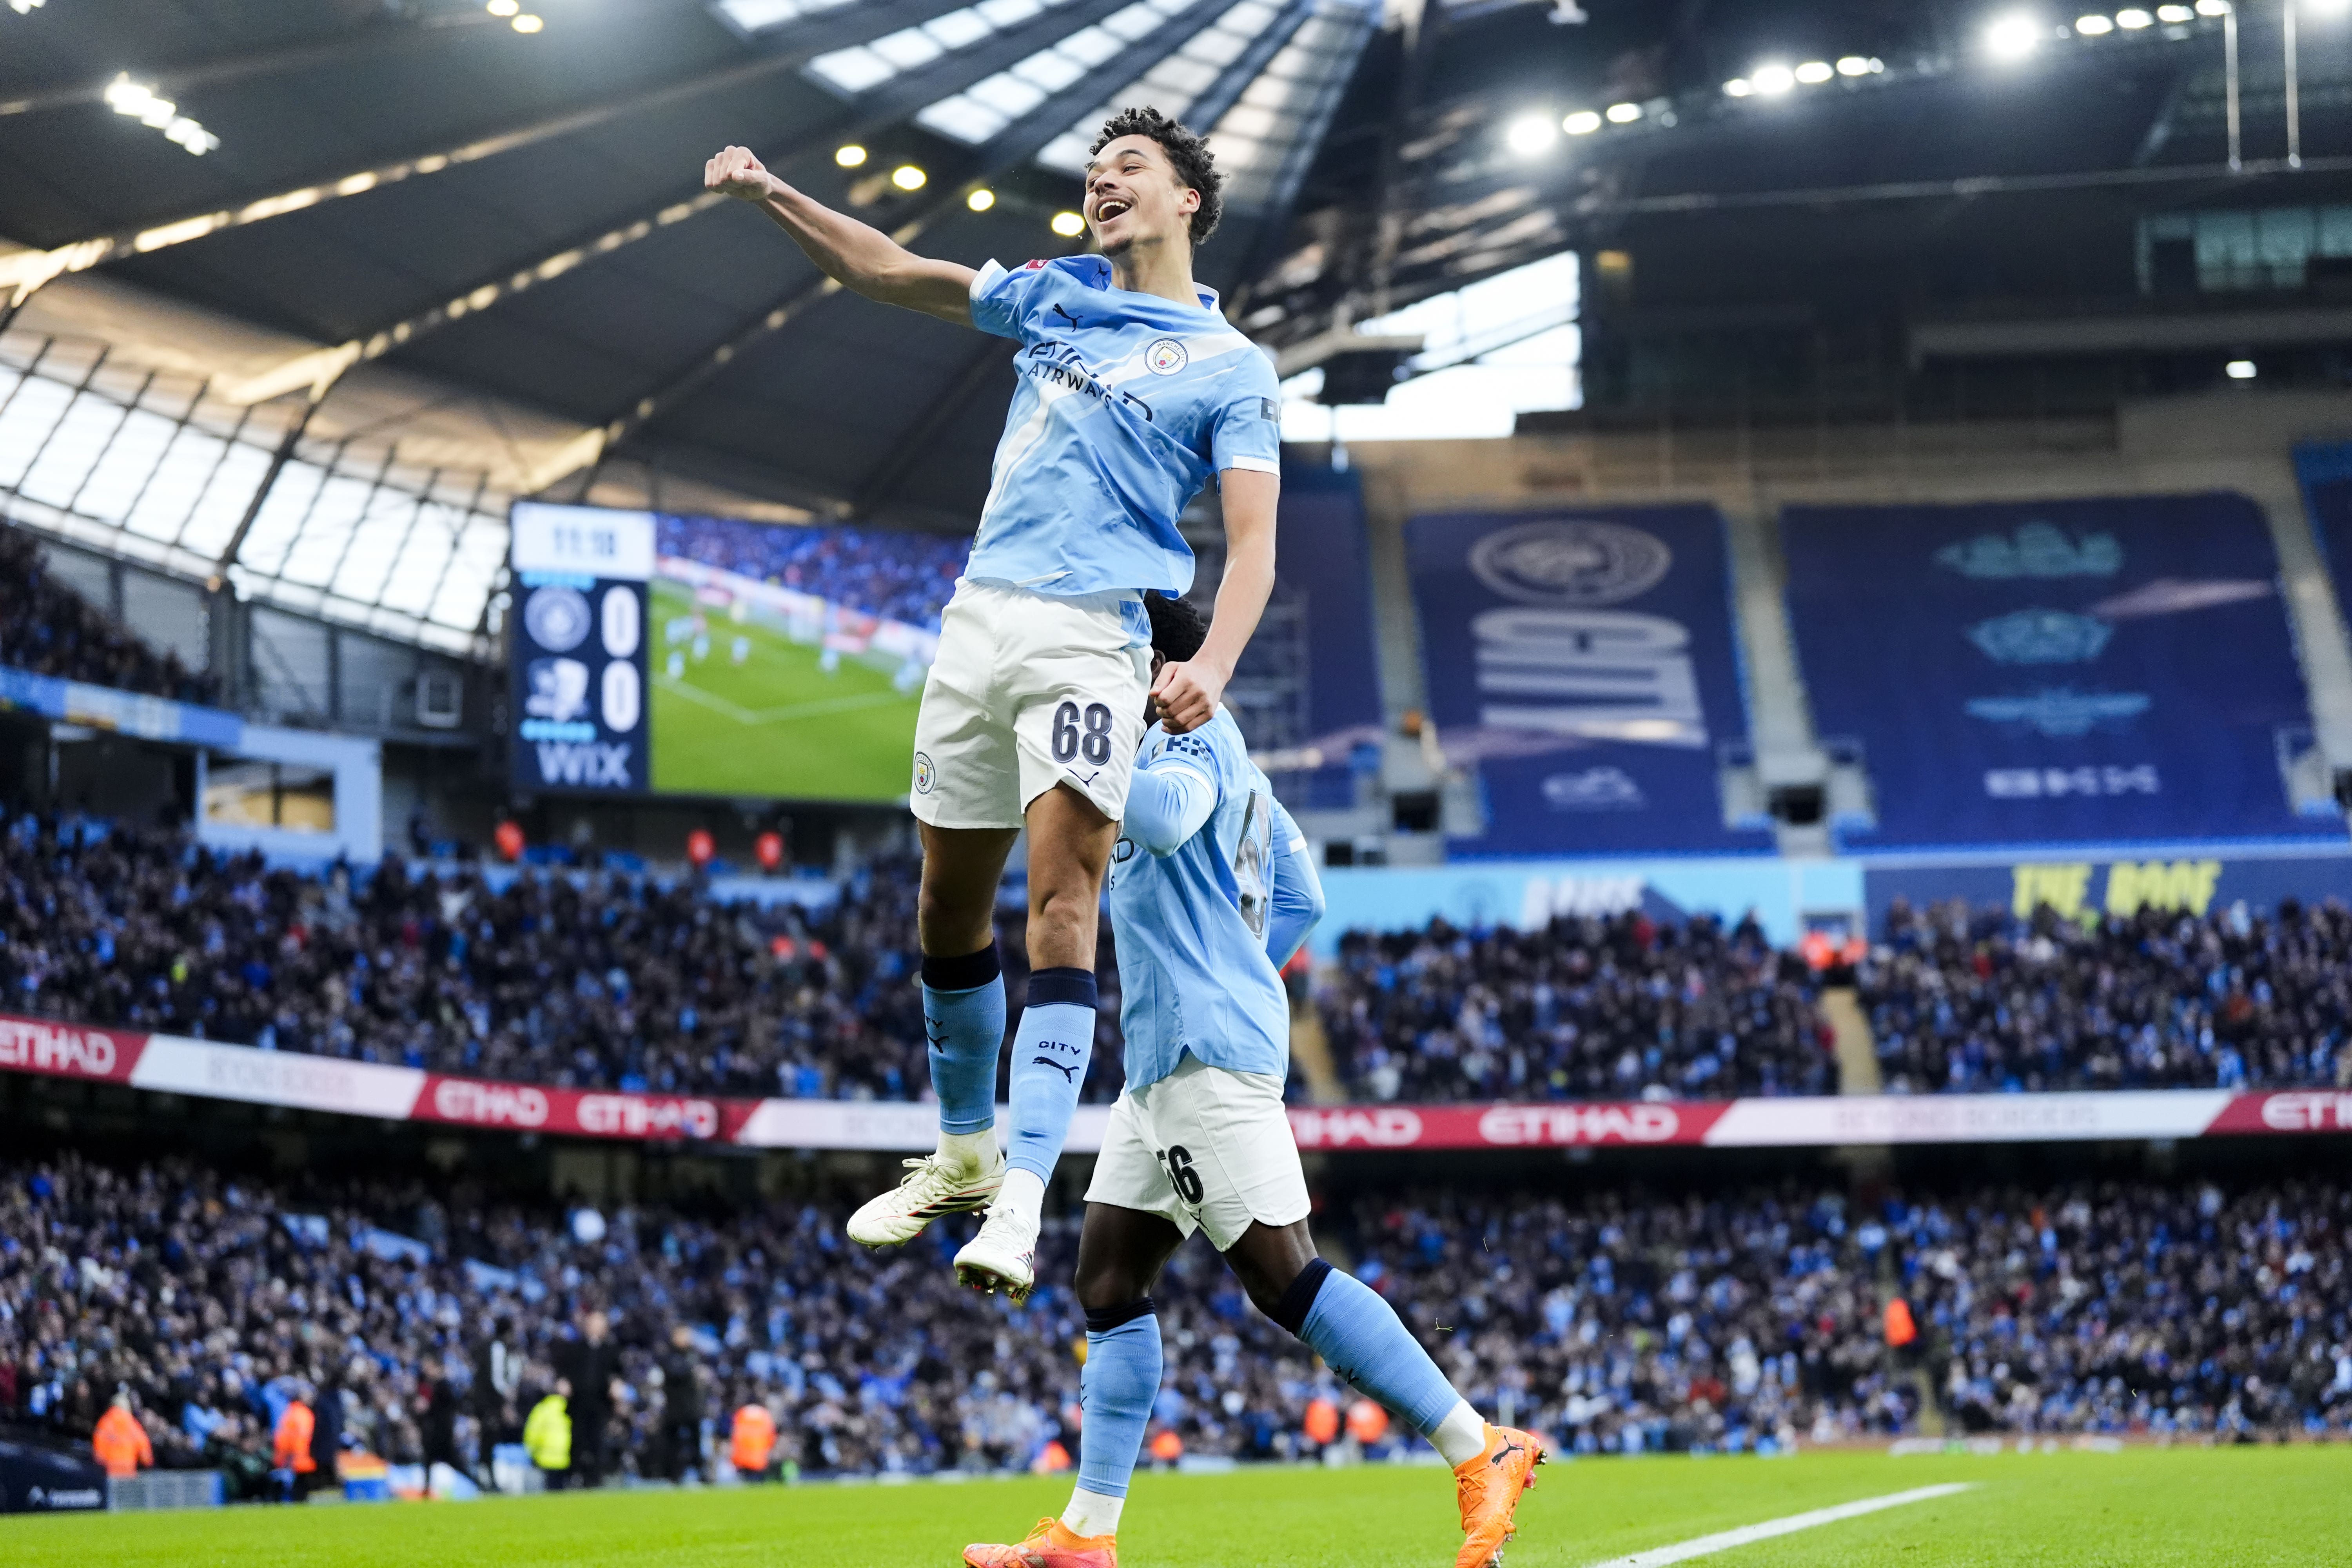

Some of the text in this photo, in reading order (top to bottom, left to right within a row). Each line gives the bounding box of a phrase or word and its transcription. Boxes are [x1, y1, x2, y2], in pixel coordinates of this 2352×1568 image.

[1157, 342, 1185, 363] MANCHESTER
[1027, 363, 1112, 409] AIRWAYS
[601, 586, 640, 658] 0
[601, 659, 640, 733] 0
[1051, 701, 1112, 766] 68
[926, 1016, 944, 1028] TY
[1039, 1041, 1081, 1055] CITY
[435, 1080, 549, 1127] ETIHAD
[576, 1094, 718, 1138] ETIHAD
[1479, 1103, 1680, 1144] ETIHAD
[2261, 1092, 2352, 1129] ETI
[1286, 1108, 1423, 1147] IHAD
